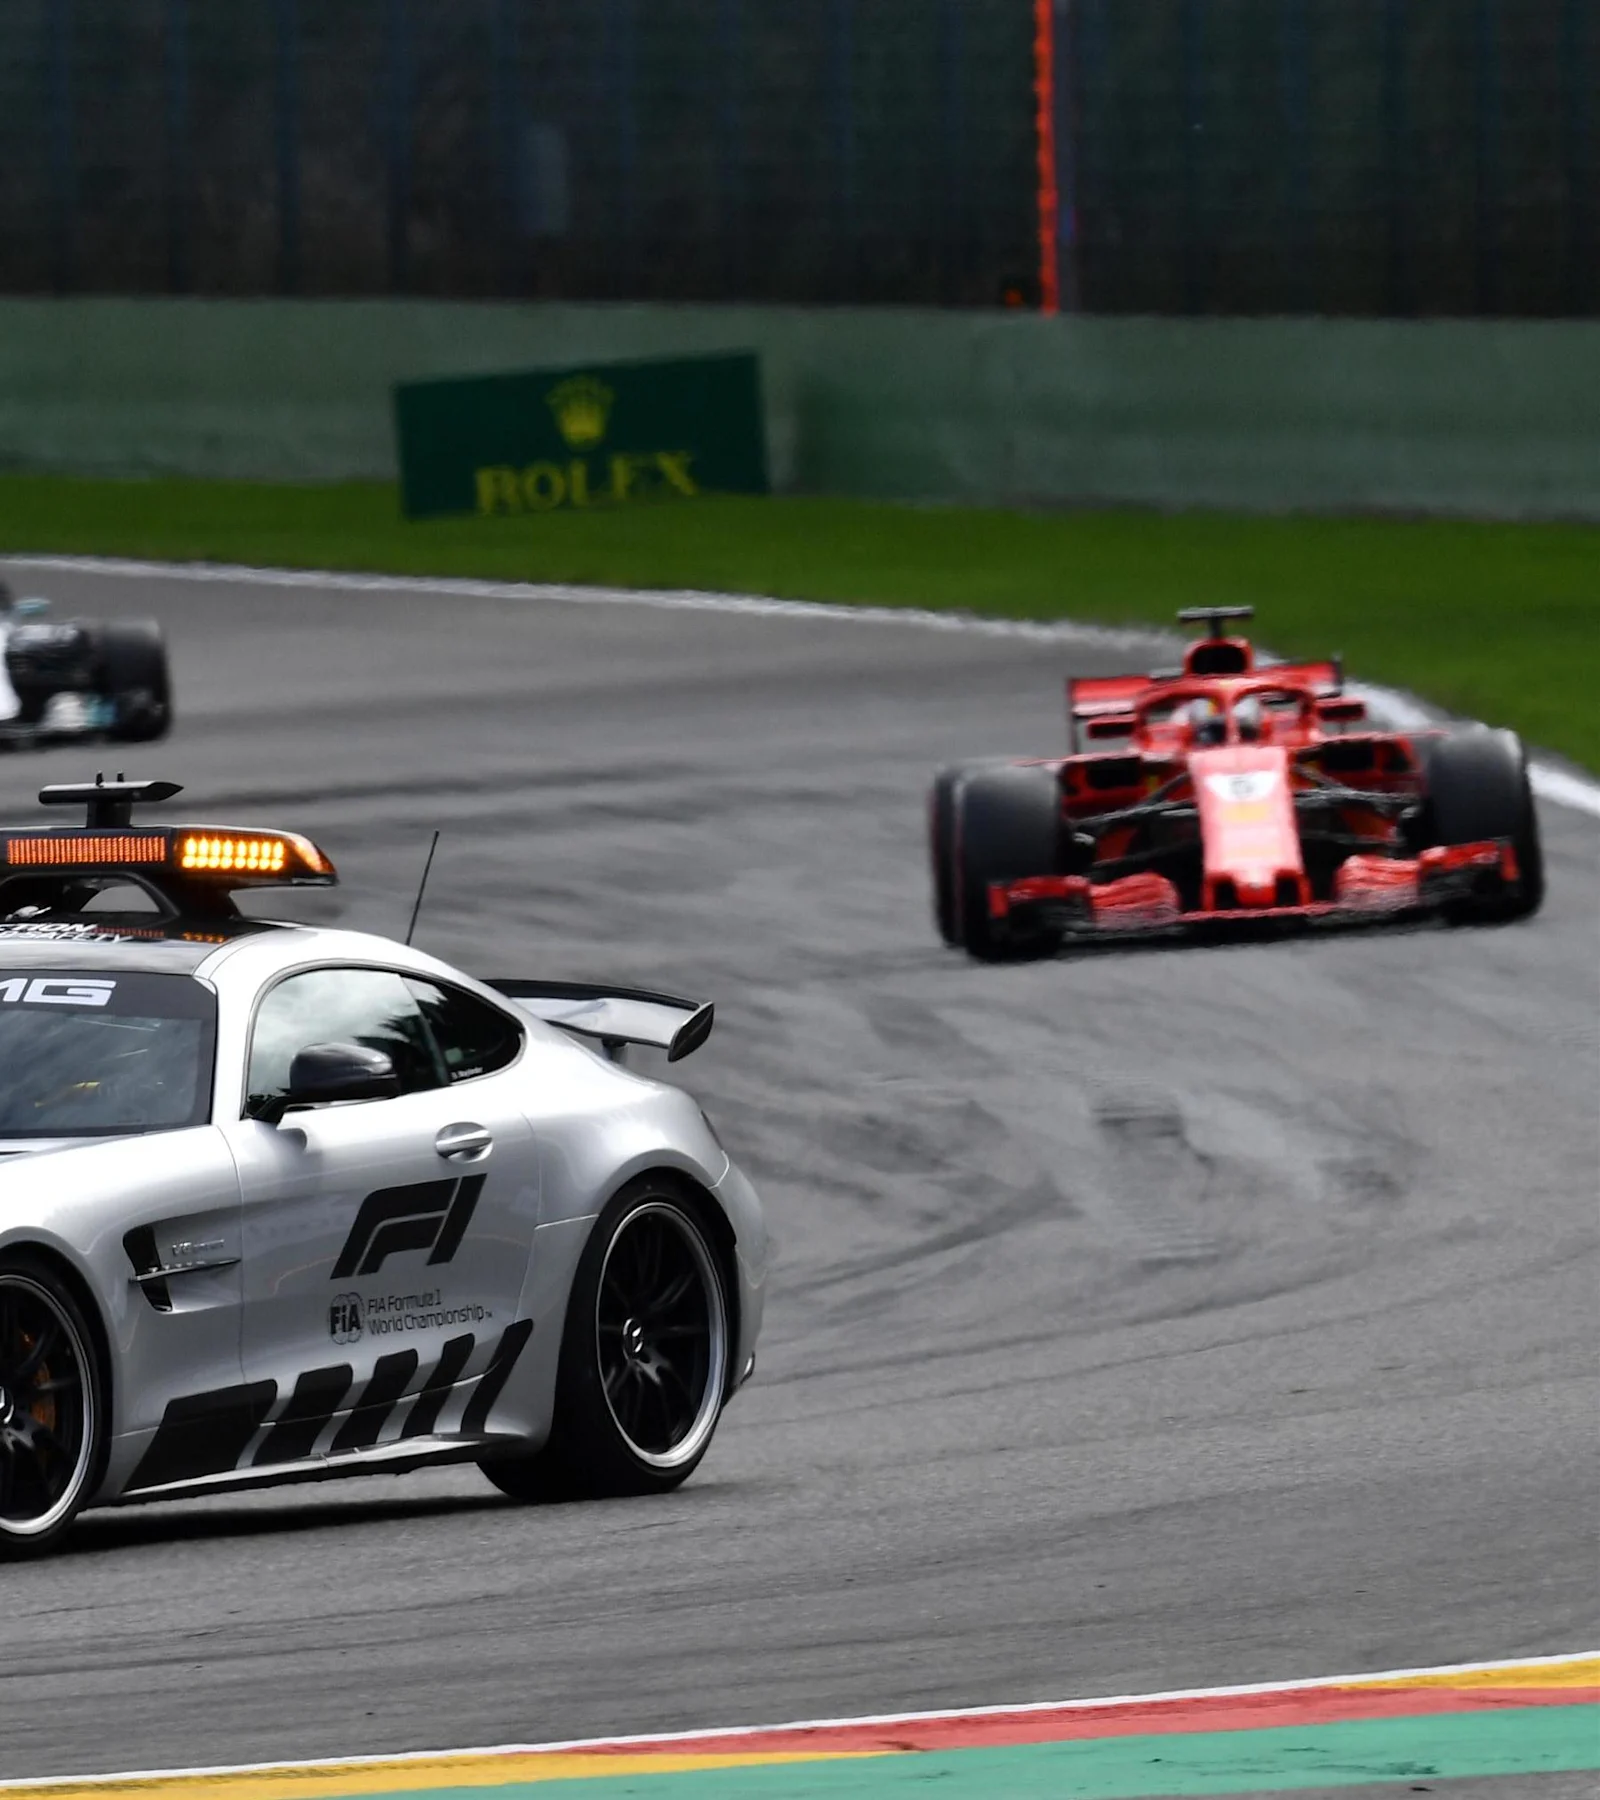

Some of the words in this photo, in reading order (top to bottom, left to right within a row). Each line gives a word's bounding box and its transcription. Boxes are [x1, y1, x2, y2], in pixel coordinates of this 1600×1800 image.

[475, 451, 697, 516] ROLEX
[367, 1298, 386, 1315] FIA
[388, 1293, 433, 1312] Formula
[368, 1314, 403, 1336] World
